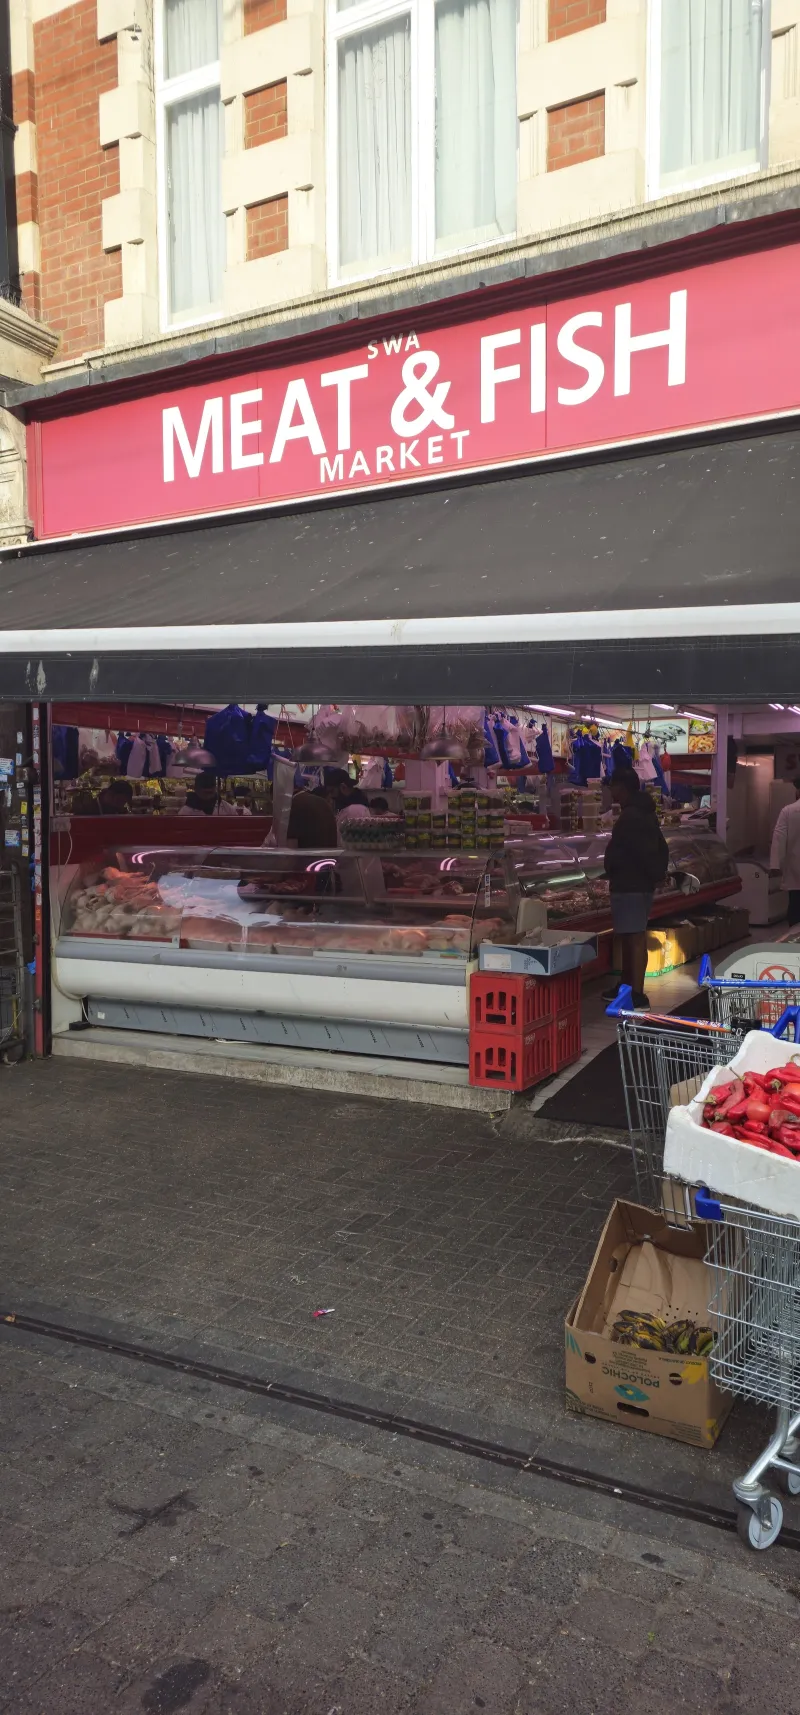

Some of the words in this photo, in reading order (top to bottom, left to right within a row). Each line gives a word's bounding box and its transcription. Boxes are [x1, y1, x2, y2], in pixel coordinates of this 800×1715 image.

[366, 330, 421, 360] SWA
[161, 364, 370, 483] MEAT
[389, 350, 455, 438] &
[479, 289, 688, 424] FISH
[318, 430, 471, 484] MARKET
[601, 1367, 660, 1389] POLOCHIC
